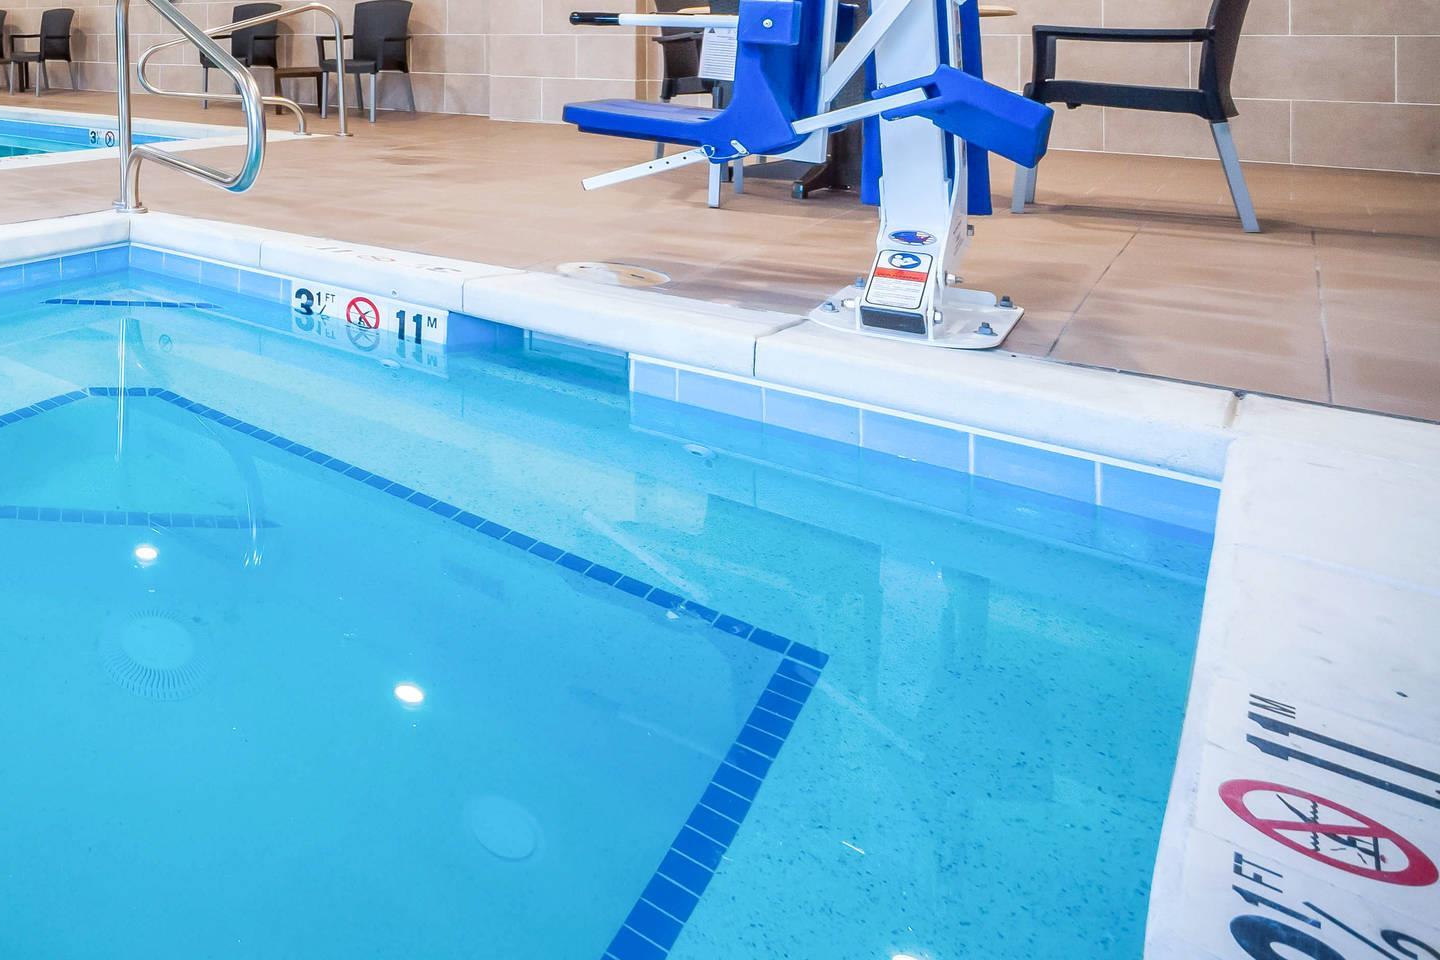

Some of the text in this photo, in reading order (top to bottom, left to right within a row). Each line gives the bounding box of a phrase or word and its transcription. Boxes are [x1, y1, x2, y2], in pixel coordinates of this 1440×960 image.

[325, 293, 336, 304] FT
[427, 316, 438, 329] M
[1232, 851, 1284, 894] FT
